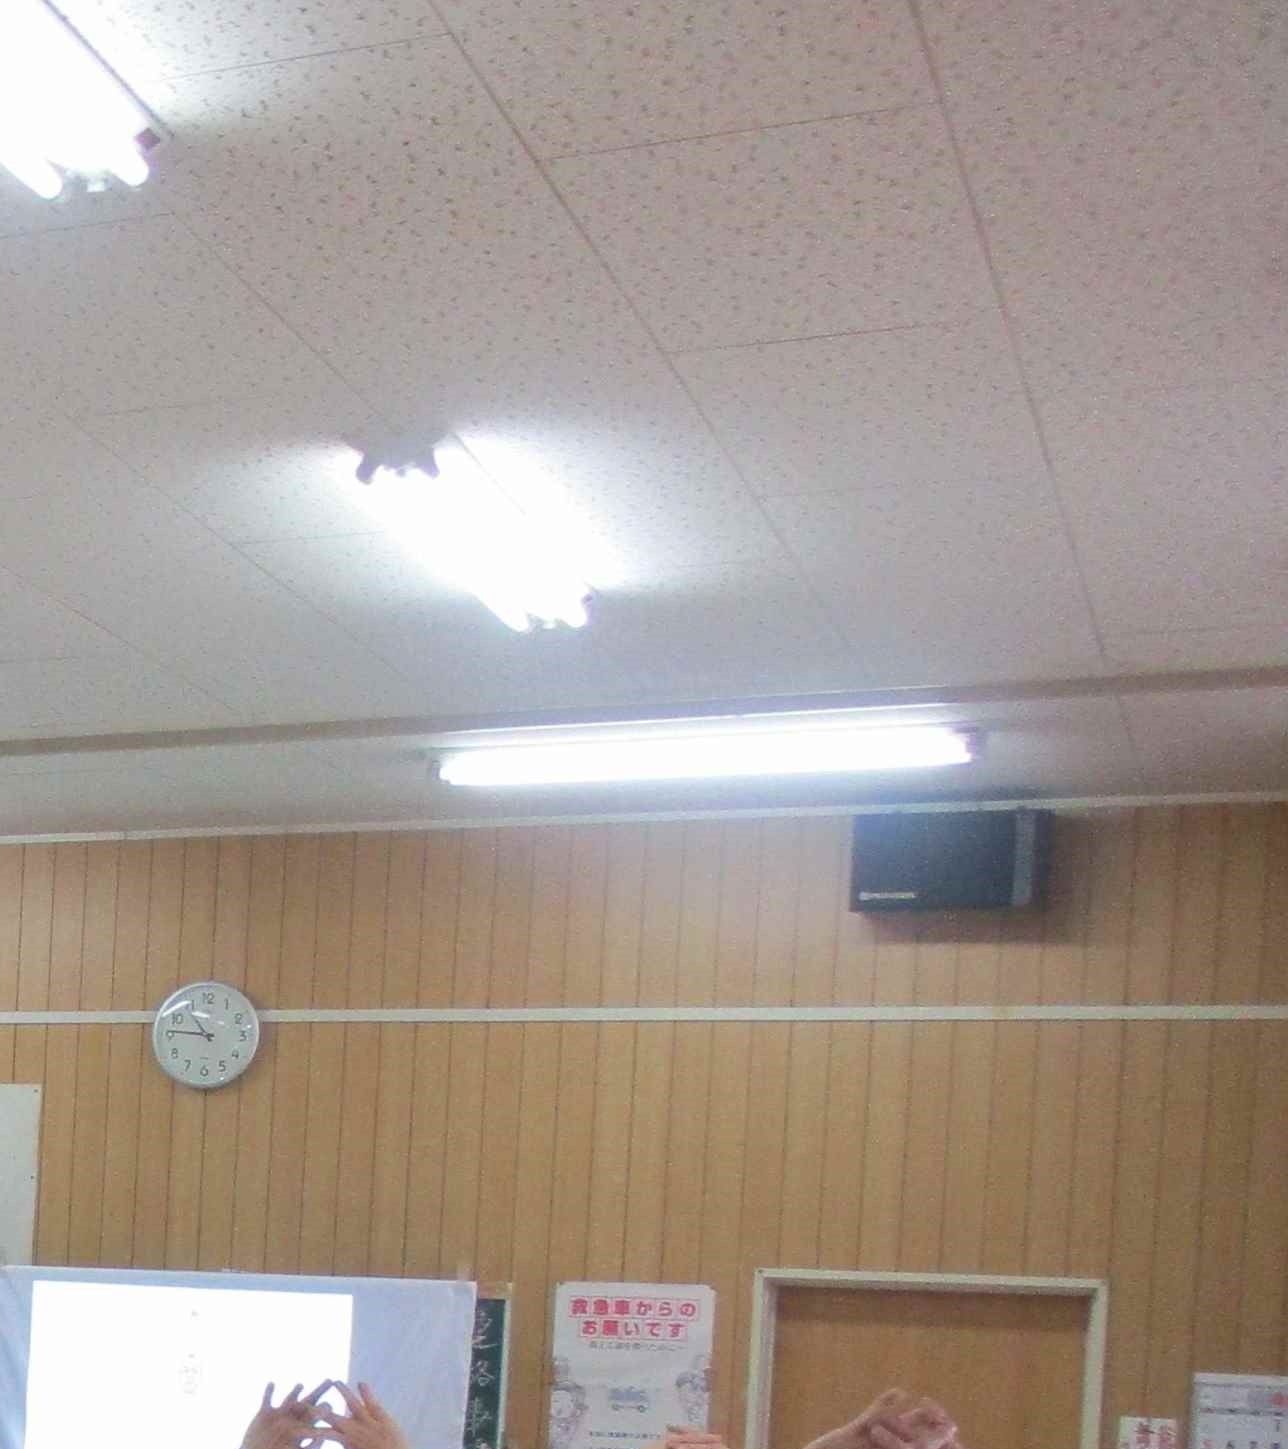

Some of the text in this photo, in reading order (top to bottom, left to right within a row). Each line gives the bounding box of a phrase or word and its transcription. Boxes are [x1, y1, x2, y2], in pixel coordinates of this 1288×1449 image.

[202, 992, 215, 1005] 12
[224, 998, 231, 1010] 1
[172, 1013, 184, 1025] 10
[234, 1013, 243, 1024] 2
[166, 1030, 174, 1041] 9
[239, 1030, 247, 1042] 3
[170, 1048, 179, 1059] 8
[232, 1049, 239, 1059] 4
[184, 1059, 192, 1072] 7
[200, 1065, 209, 1077] 6
[219, 1060, 227, 1072] 5
[570, 1297, 697, 1319] 救急車からの
[580, 1319, 687, 1338] お願いです
